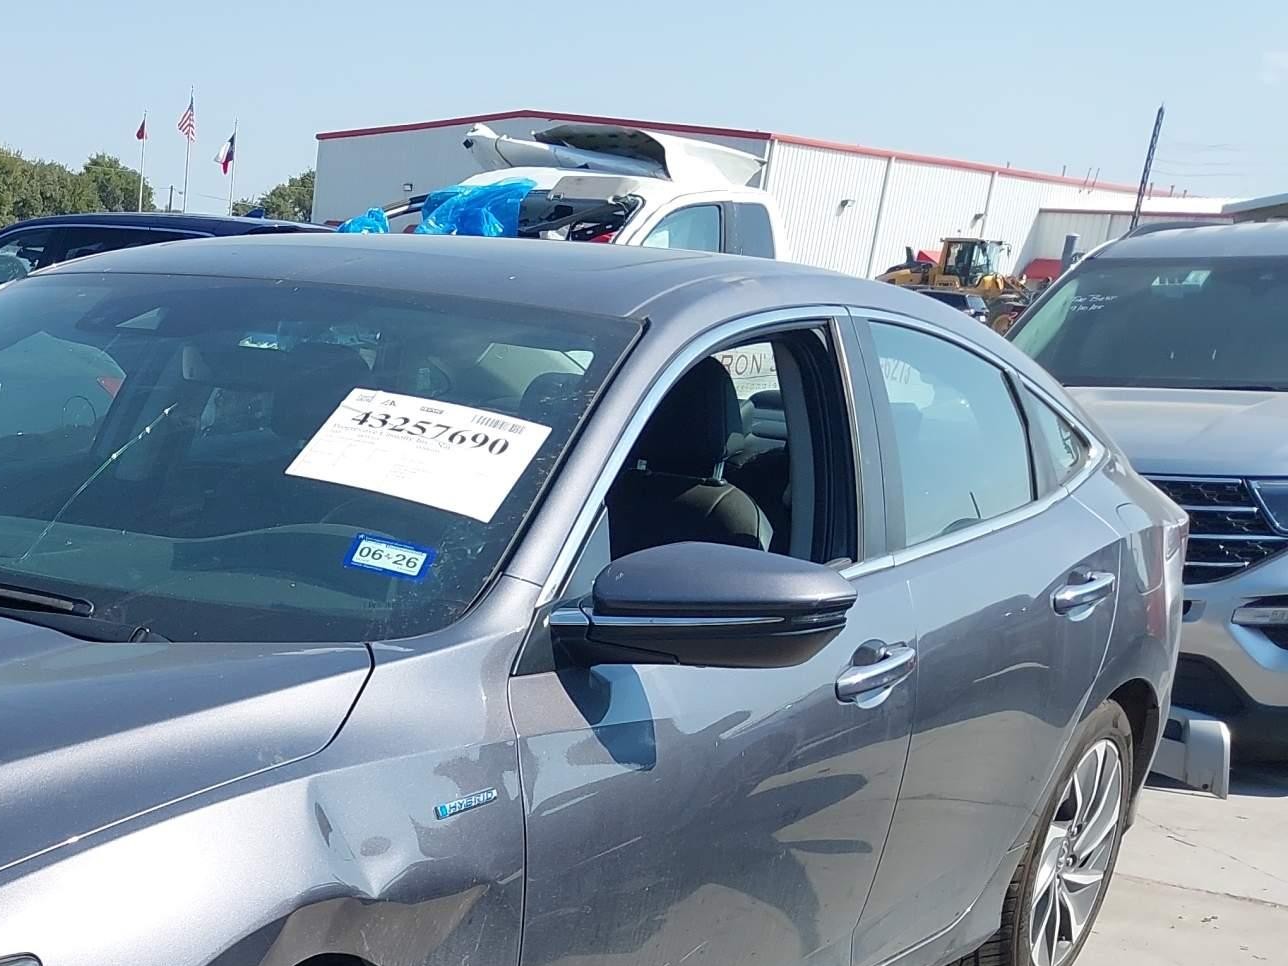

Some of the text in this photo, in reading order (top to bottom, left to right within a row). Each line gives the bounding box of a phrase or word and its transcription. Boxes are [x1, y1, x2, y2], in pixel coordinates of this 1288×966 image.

[352, 409, 510, 456] 43257690
[358, 545, 385, 562] 06
[391, 552, 420, 570] 26
[448, 790, 495, 813] HYBRID
